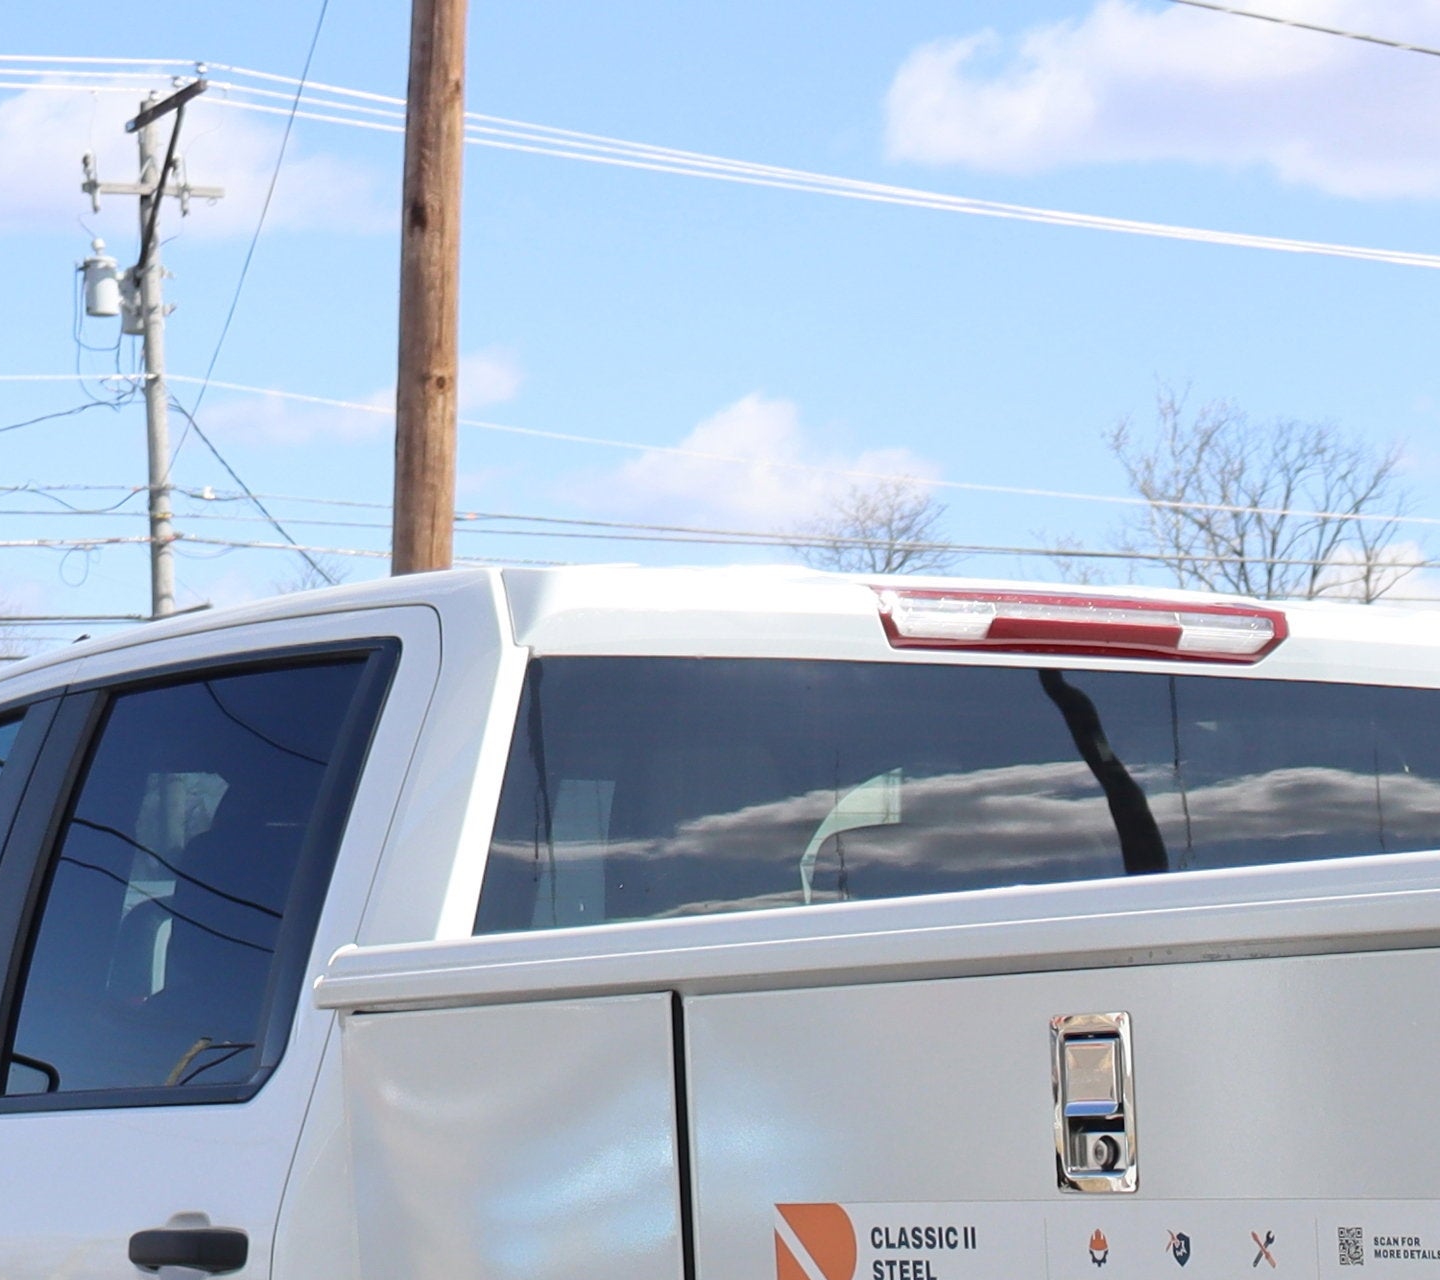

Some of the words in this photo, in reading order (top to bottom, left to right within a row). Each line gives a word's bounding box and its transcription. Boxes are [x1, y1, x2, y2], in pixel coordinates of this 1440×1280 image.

[870, 1226, 958, 1250] CLASSIC
[963, 1226, 977, 1250] II
[1373, 1236, 1400, 1247] SCAN
[1401, 1237, 1421, 1247] FOR
[1374, 1249, 1402, 1259] MORE
